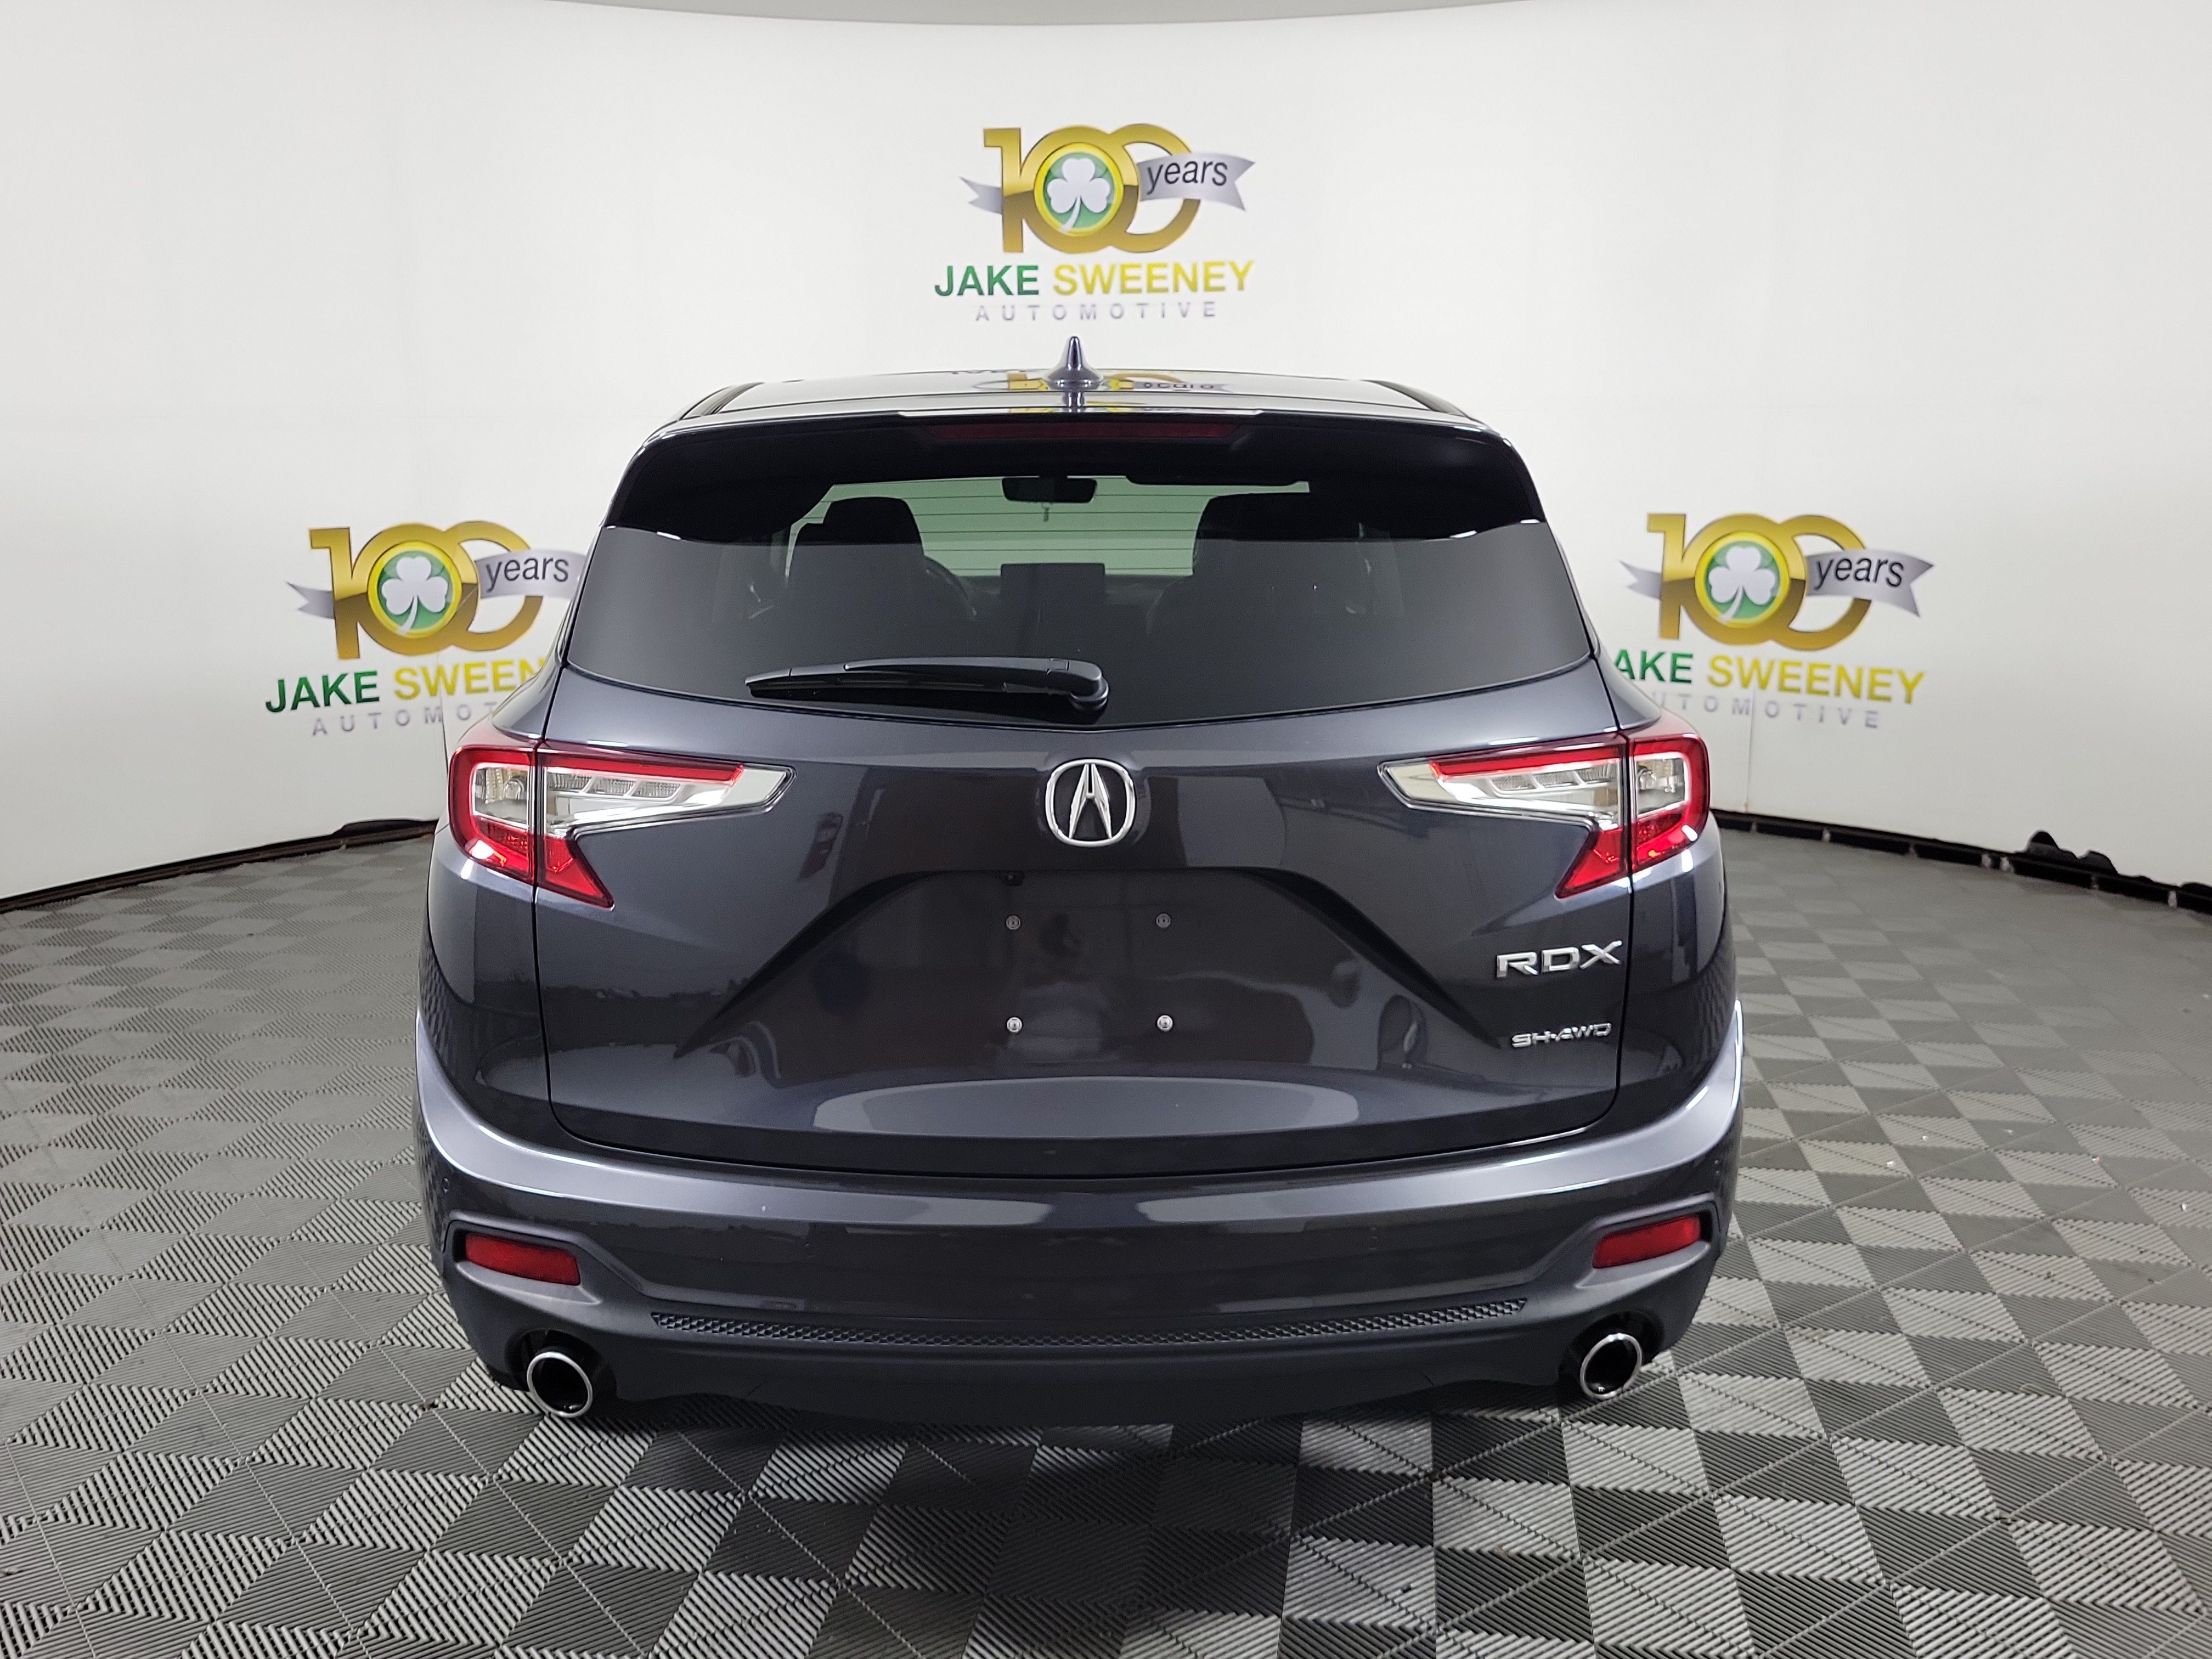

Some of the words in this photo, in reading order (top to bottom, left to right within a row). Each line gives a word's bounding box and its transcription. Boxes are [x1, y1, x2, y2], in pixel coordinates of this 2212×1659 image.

[1147, 160, 1228, 195] years
[934, 265, 1039, 296] JAKE
[1053, 261, 1254, 296] SWEENEY
[975, 302, 1216, 321] AUTOMOTIVE
[486, 556, 569, 591] years
[1813, 557, 1904, 589] years
[265, 671, 380, 713] JAKE
[394, 658, 545, 700] SWEEN
[1614, 649, 1693, 684] AKE
[1707, 654, 1926, 704] SWEENEY
[312, 702, 497, 737] AUTOMOT
[1652, 690, 1879, 729] TOMOTIVE
[1496, 940, 1622, 978] RDX
